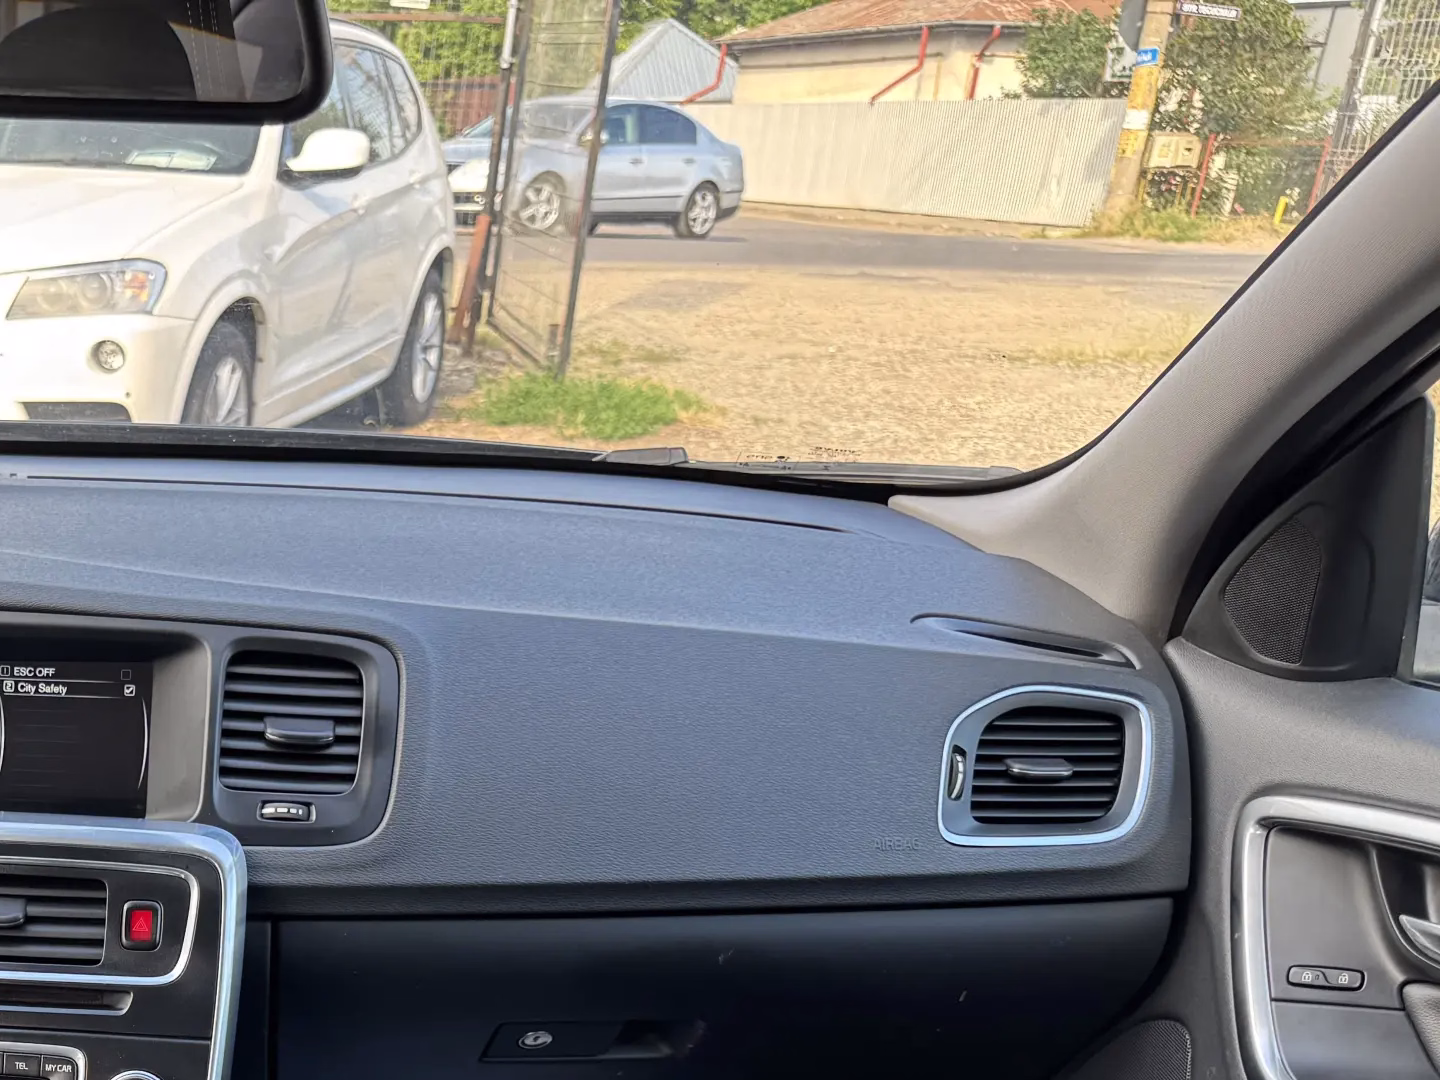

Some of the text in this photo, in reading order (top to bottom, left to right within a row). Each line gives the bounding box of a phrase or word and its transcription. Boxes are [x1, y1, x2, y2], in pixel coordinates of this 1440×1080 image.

[14, 667, 34, 676] ESC
[36, 668, 56, 677] OFF
[18, 683, 36, 693] City
[39, 684, 67, 695] Safety
[15, 1062, 28, 1070] TEL
